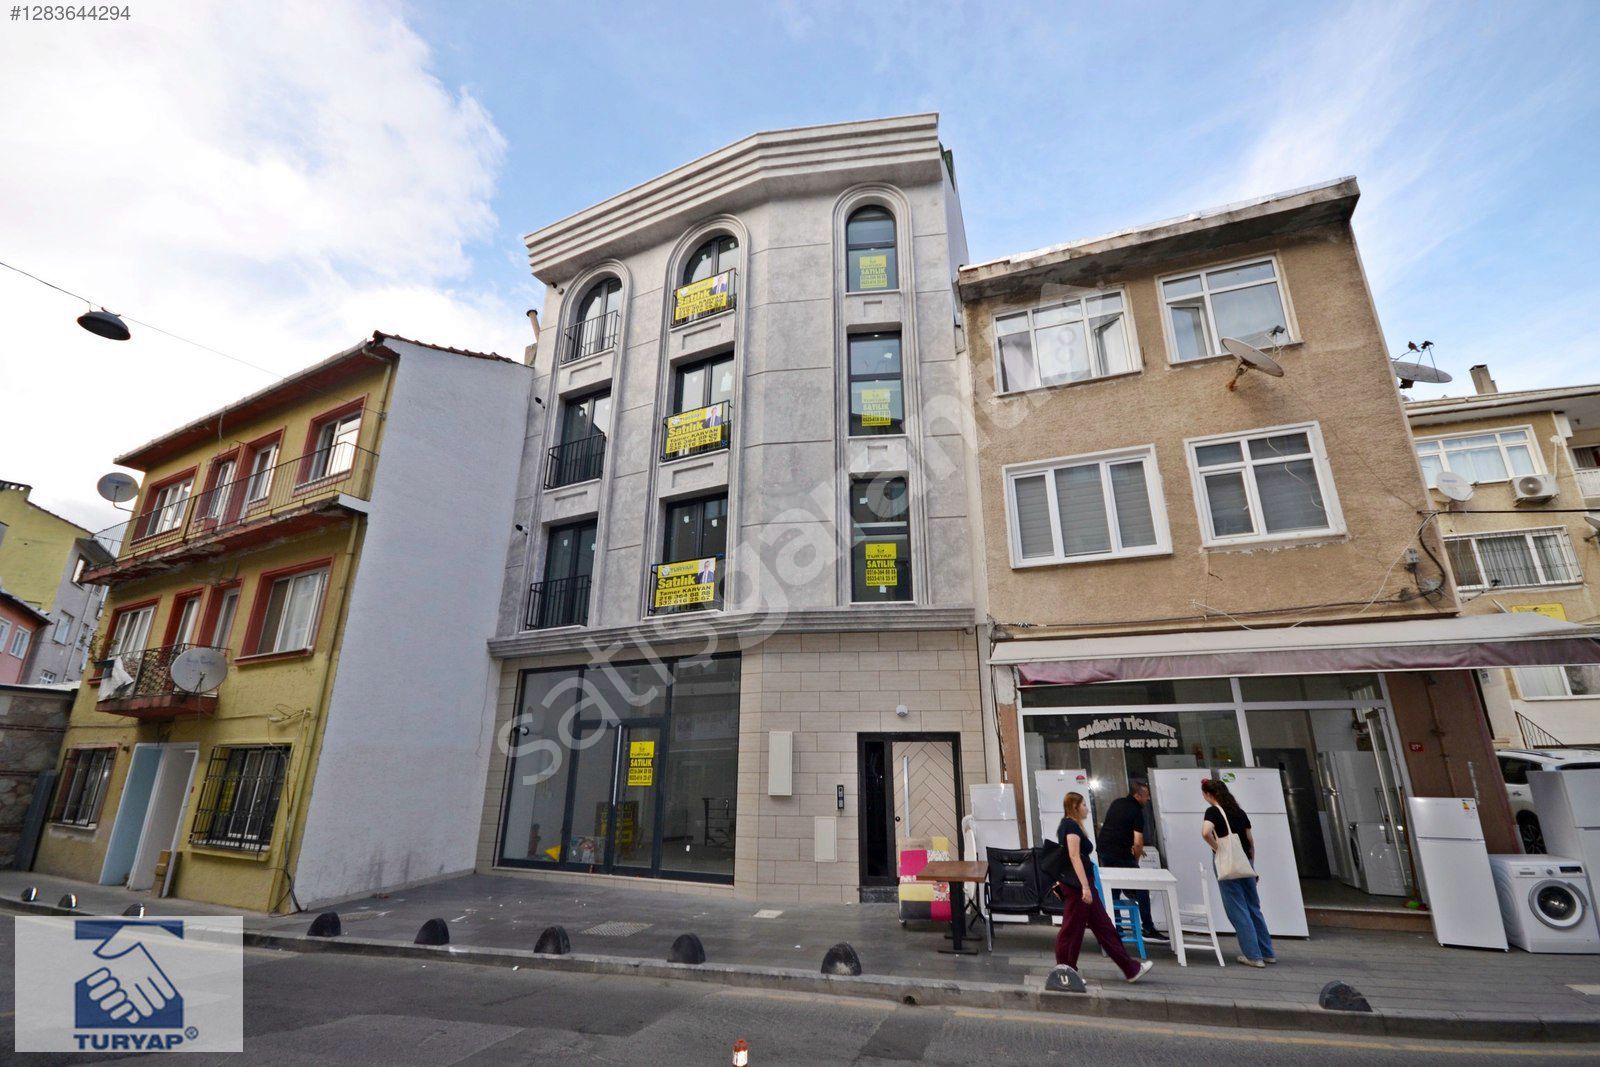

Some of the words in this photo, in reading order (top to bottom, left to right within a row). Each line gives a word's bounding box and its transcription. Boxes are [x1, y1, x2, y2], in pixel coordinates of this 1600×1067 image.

[668, 420, 703, 437] Satılık
[657, 574, 696, 589] Satılık
[682, 584, 710, 592] KARVAN
[1123, 715, 1176, 738] TİCARET
